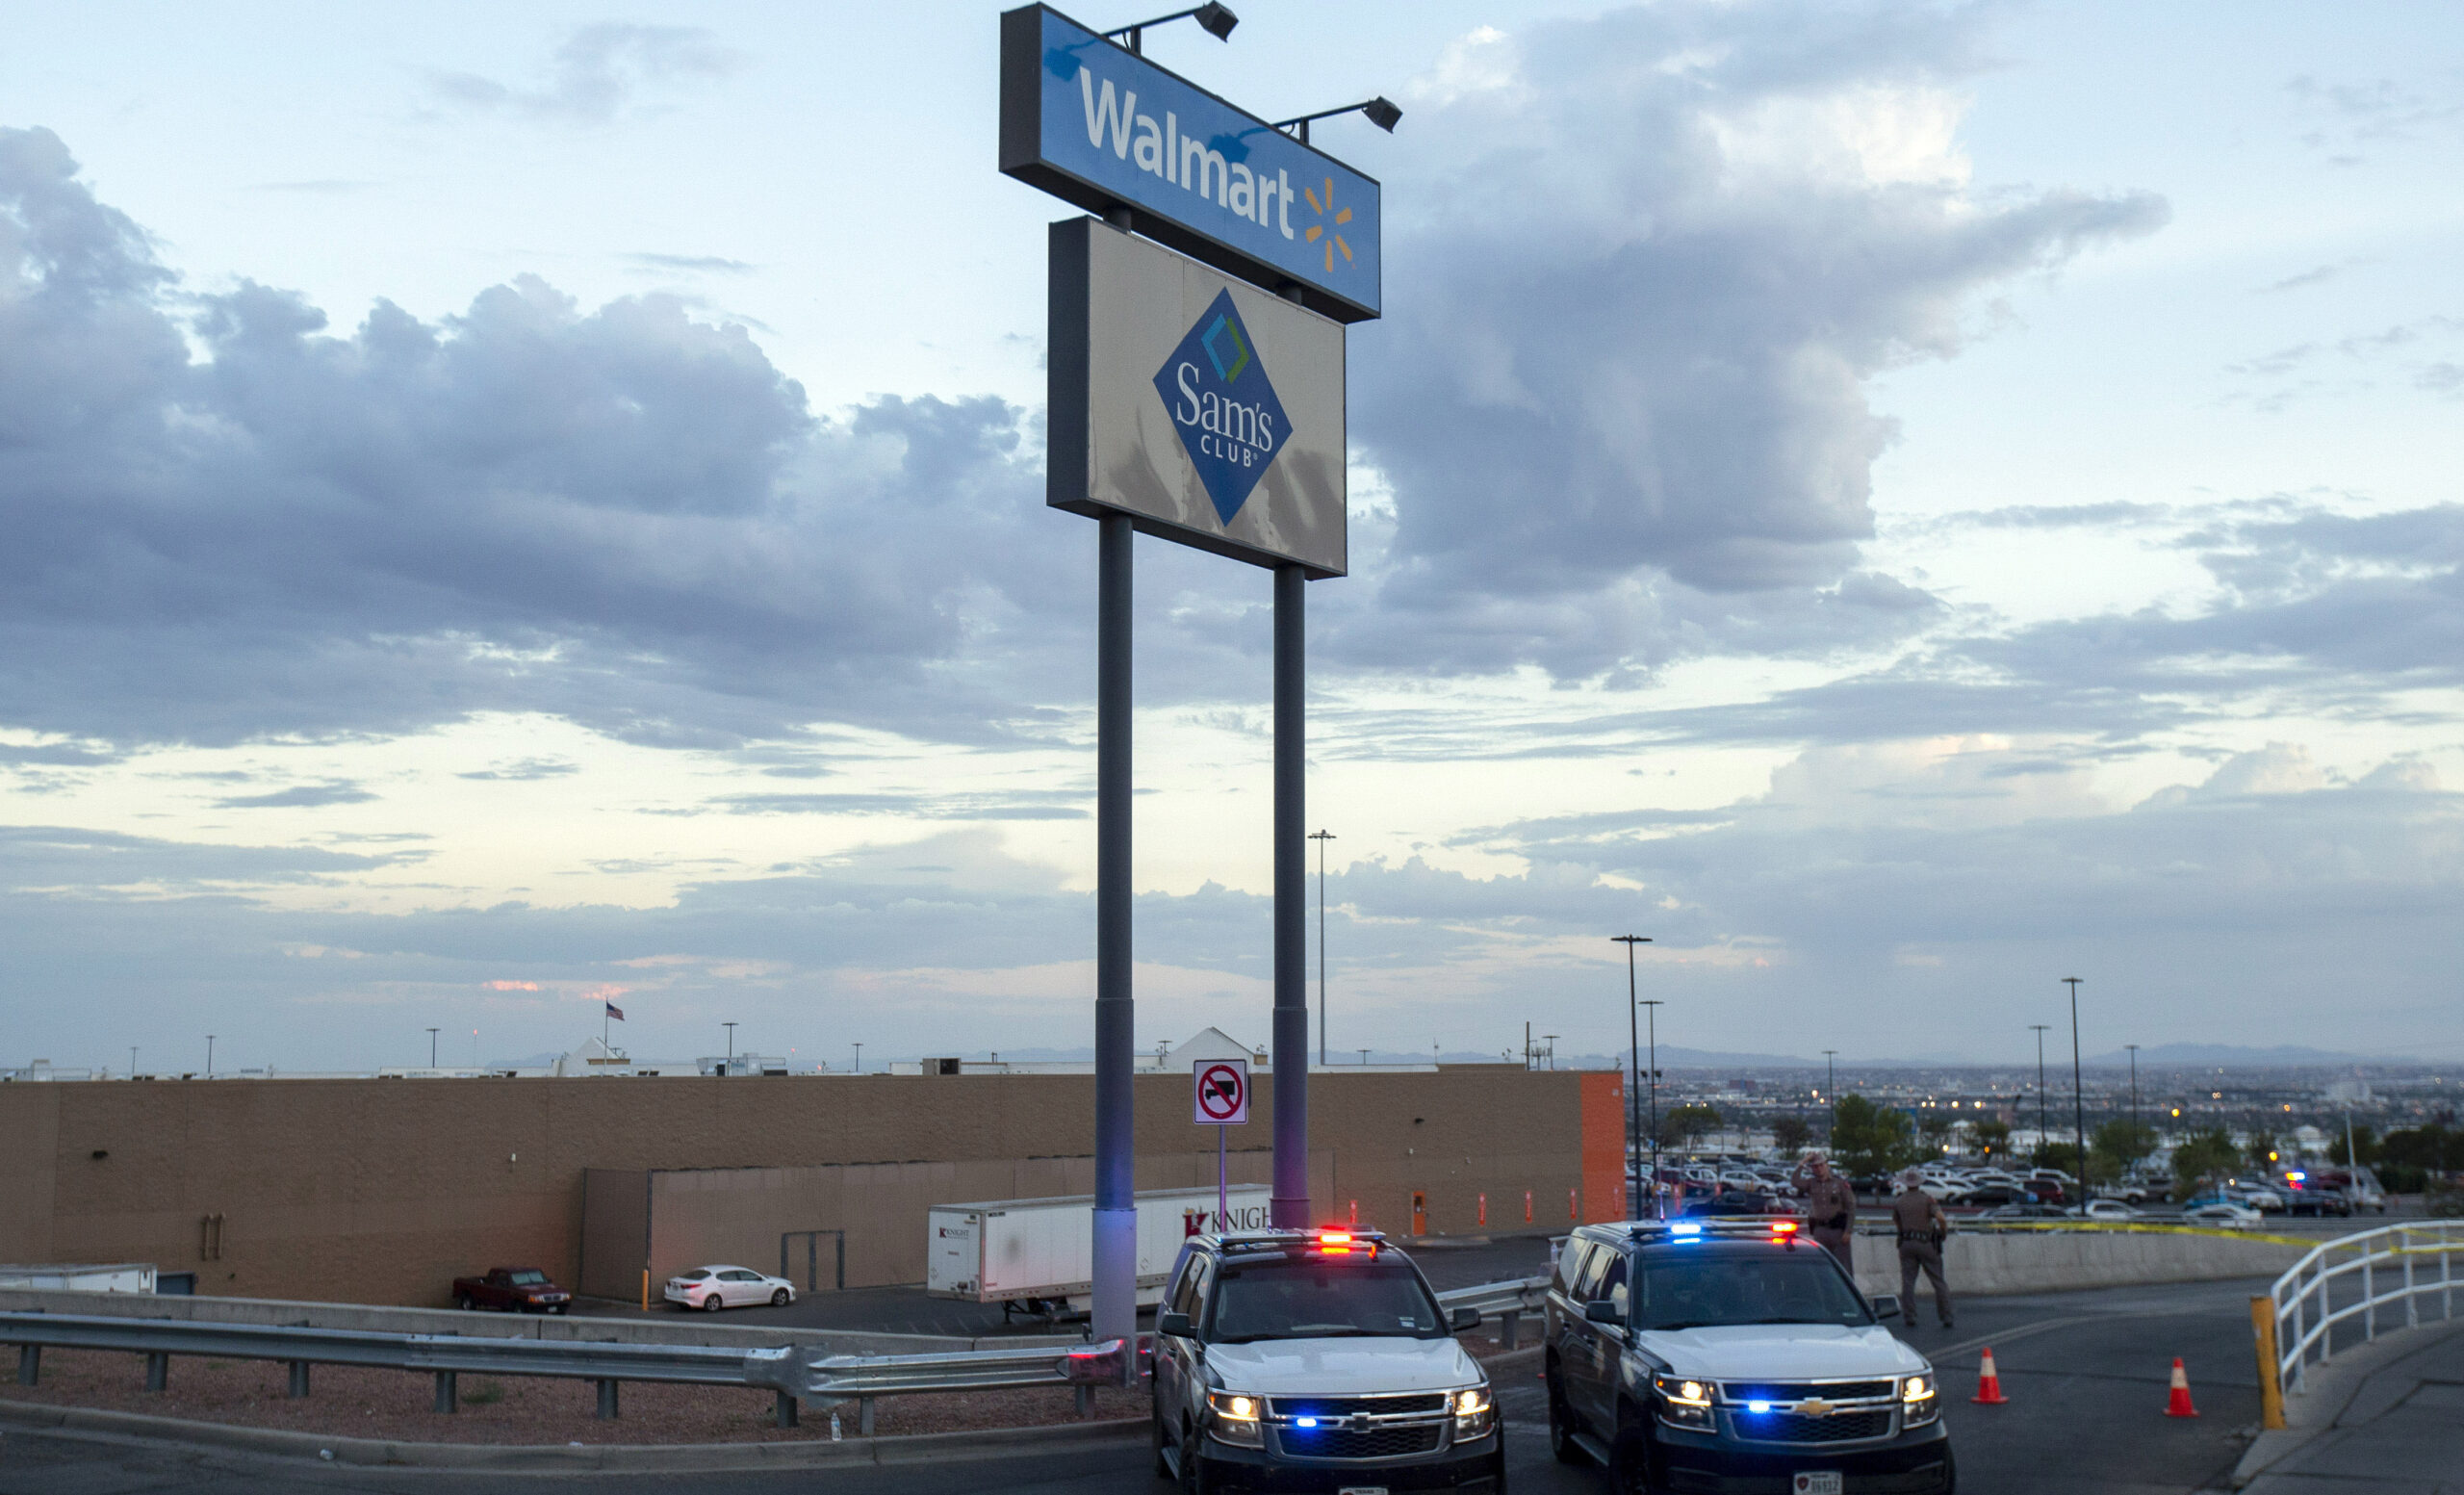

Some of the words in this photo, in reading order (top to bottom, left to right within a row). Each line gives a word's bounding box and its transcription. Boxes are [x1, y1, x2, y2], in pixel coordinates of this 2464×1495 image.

[1079, 65, 1295, 240] Walmart
[1177, 362, 1272, 452] Sam's
[1201, 434, 1251, 468] CLUB
[1211, 1206, 1270, 1232] KNIGH
